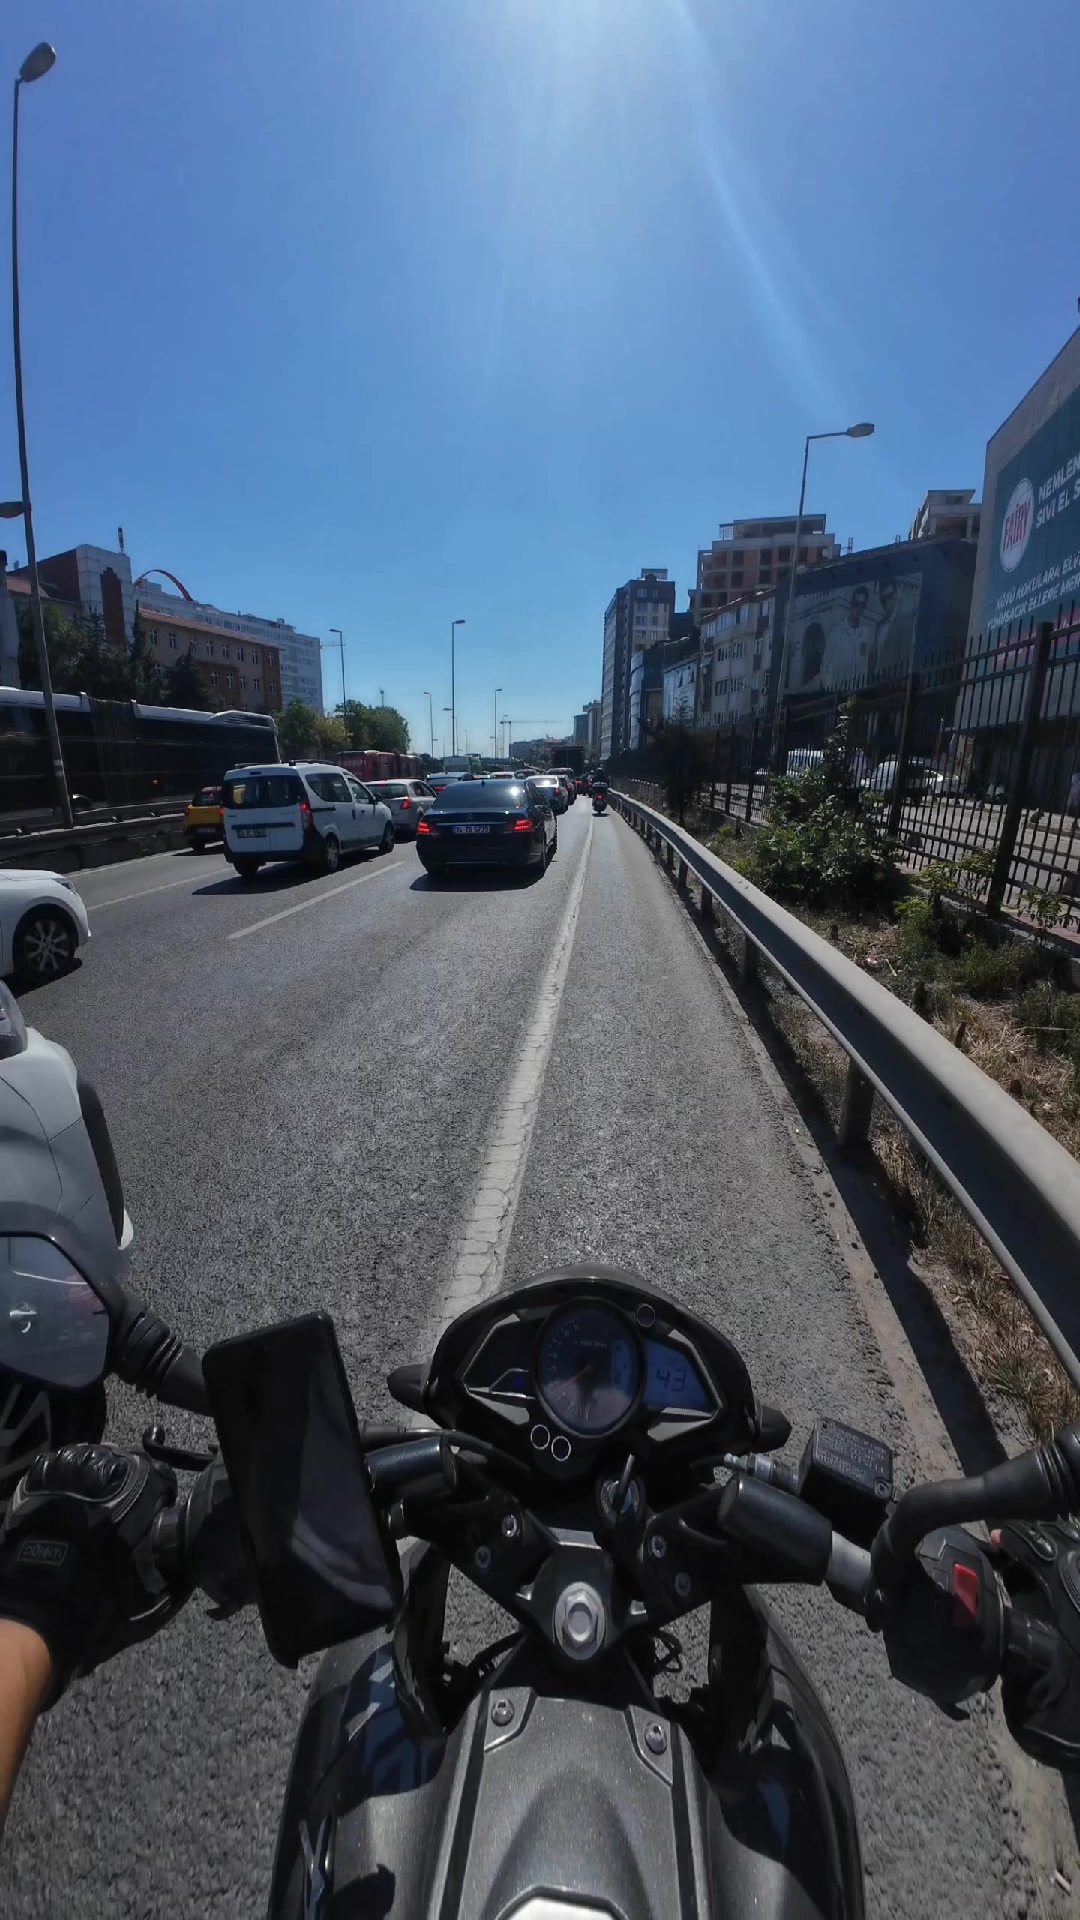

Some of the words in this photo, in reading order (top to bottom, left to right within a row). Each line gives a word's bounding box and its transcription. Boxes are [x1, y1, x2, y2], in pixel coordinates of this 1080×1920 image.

[1035, 498, 1056, 529] SIVI
[1057, 488, 1070, 513] EL
[656, 1368, 688, 1393] 43
